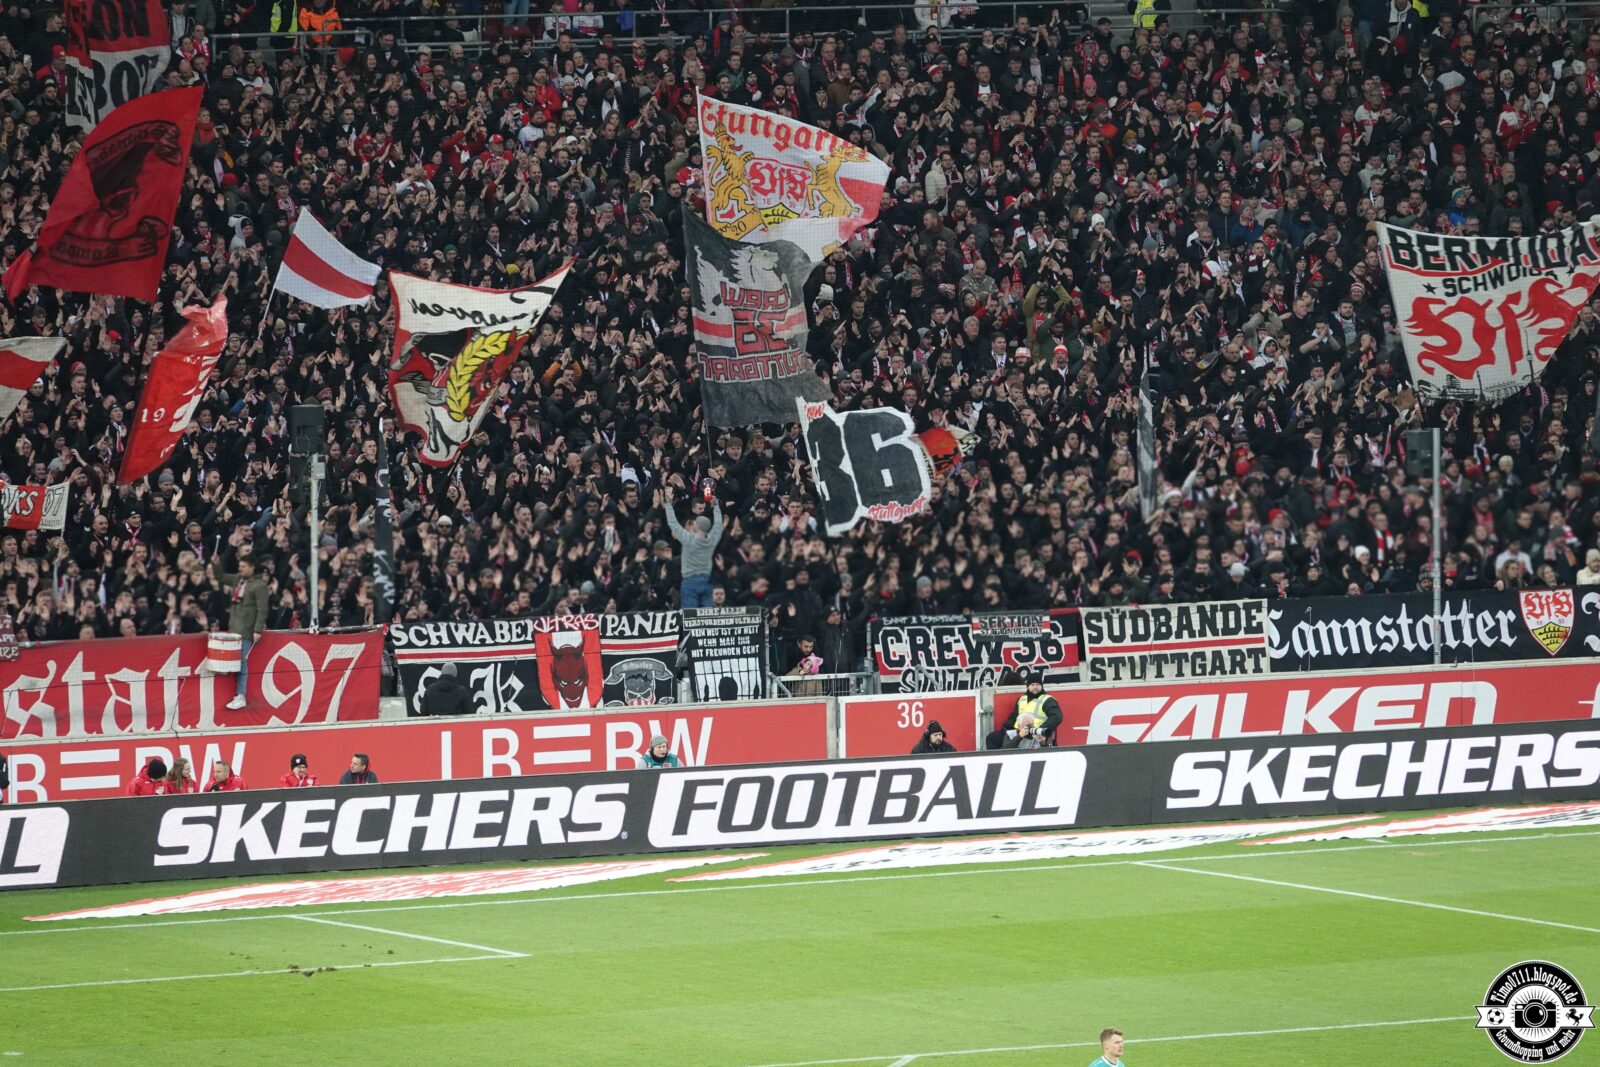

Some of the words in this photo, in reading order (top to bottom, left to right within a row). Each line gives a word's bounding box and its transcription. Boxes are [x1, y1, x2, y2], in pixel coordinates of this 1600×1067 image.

[1523, 591, 1573, 620] VfB
[598, 610, 681, 637] PANIE
[978, 615, 1044, 630] SEKTION
[1084, 600, 1264, 645] SÜDBANDE
[706, 646, 741, 657] FREUNDEN
[1090, 647, 1267, 682] STUTTGART
[261, 641, 367, 726] 97
[897, 701, 925, 729] 36
[1166, 731, 1600, 810] SKECHERS
[153, 783, 628, 867] SKECHERS
[672, 760, 1060, 836] FOOTBALL
